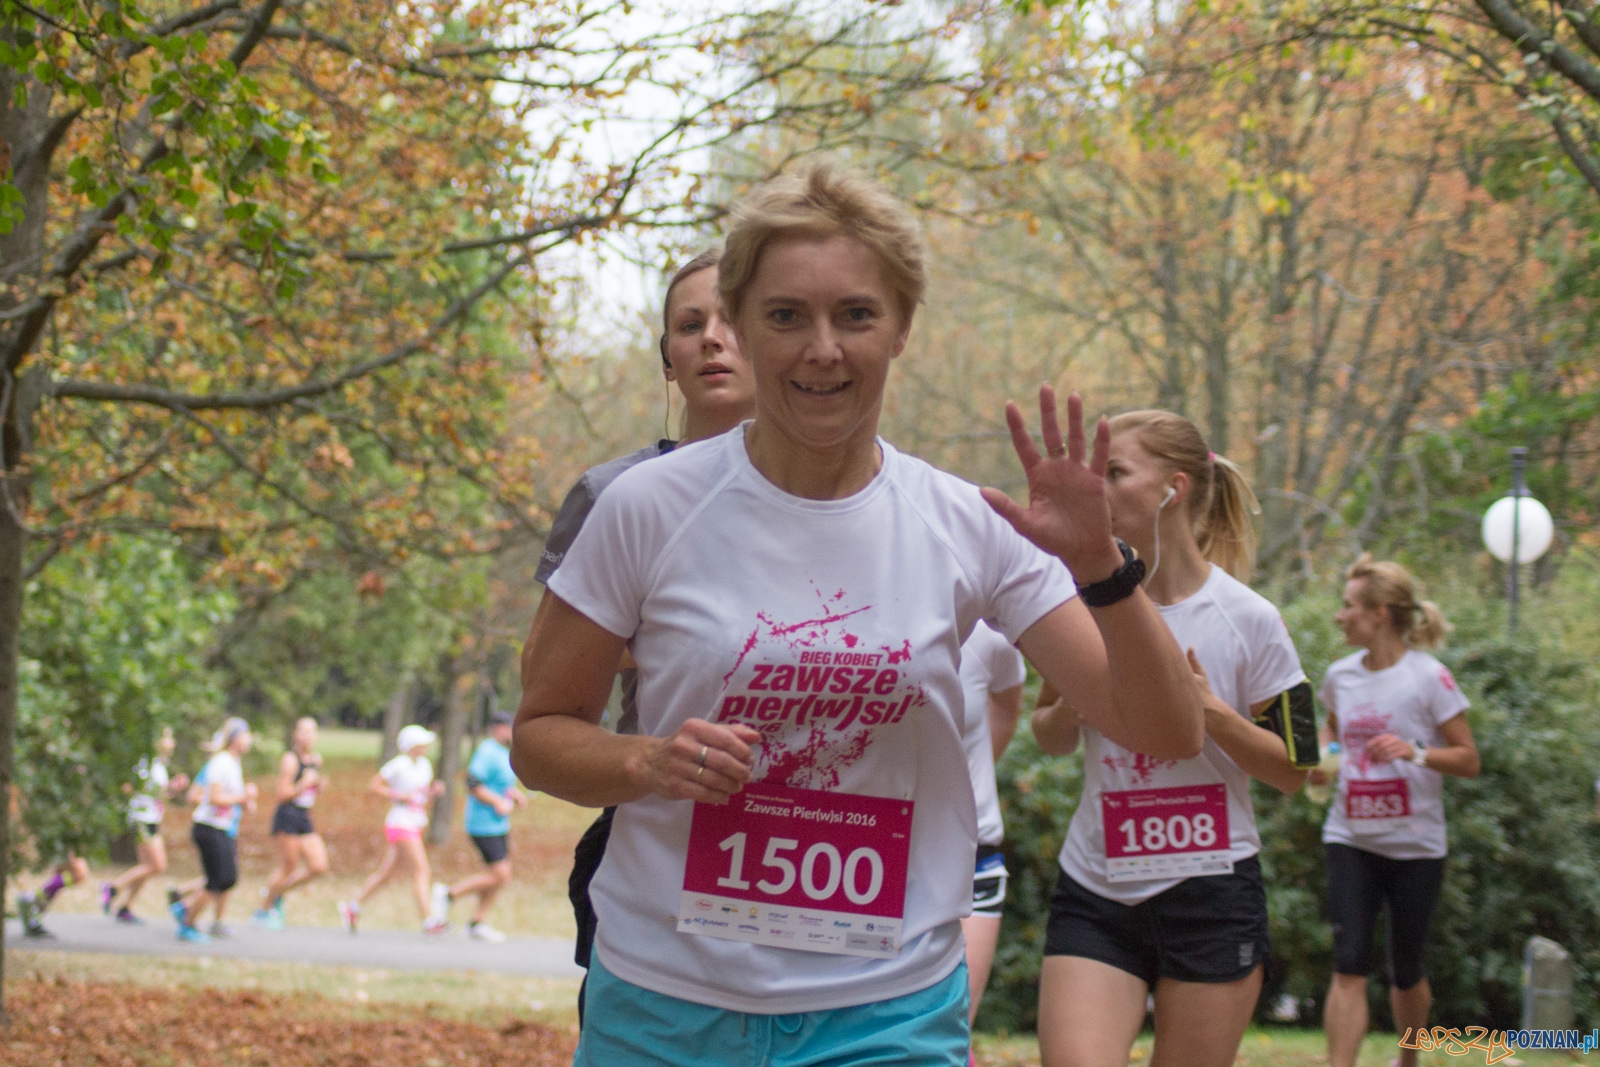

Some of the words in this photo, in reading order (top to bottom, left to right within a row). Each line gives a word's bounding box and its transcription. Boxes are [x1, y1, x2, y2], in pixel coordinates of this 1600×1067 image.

[799, 651, 832, 664] BIEG
[833, 652, 884, 666] KOBIET
[746, 664, 899, 695] zawsze
[744, 800, 791, 818] Zawsze
[792, 806, 843, 824] Pier(w)si
[845, 812, 877, 827] 2016
[1349, 794, 1403, 817] 1863
[1119, 812, 1217, 852] 1808
[717, 831, 885, 905] 1500
